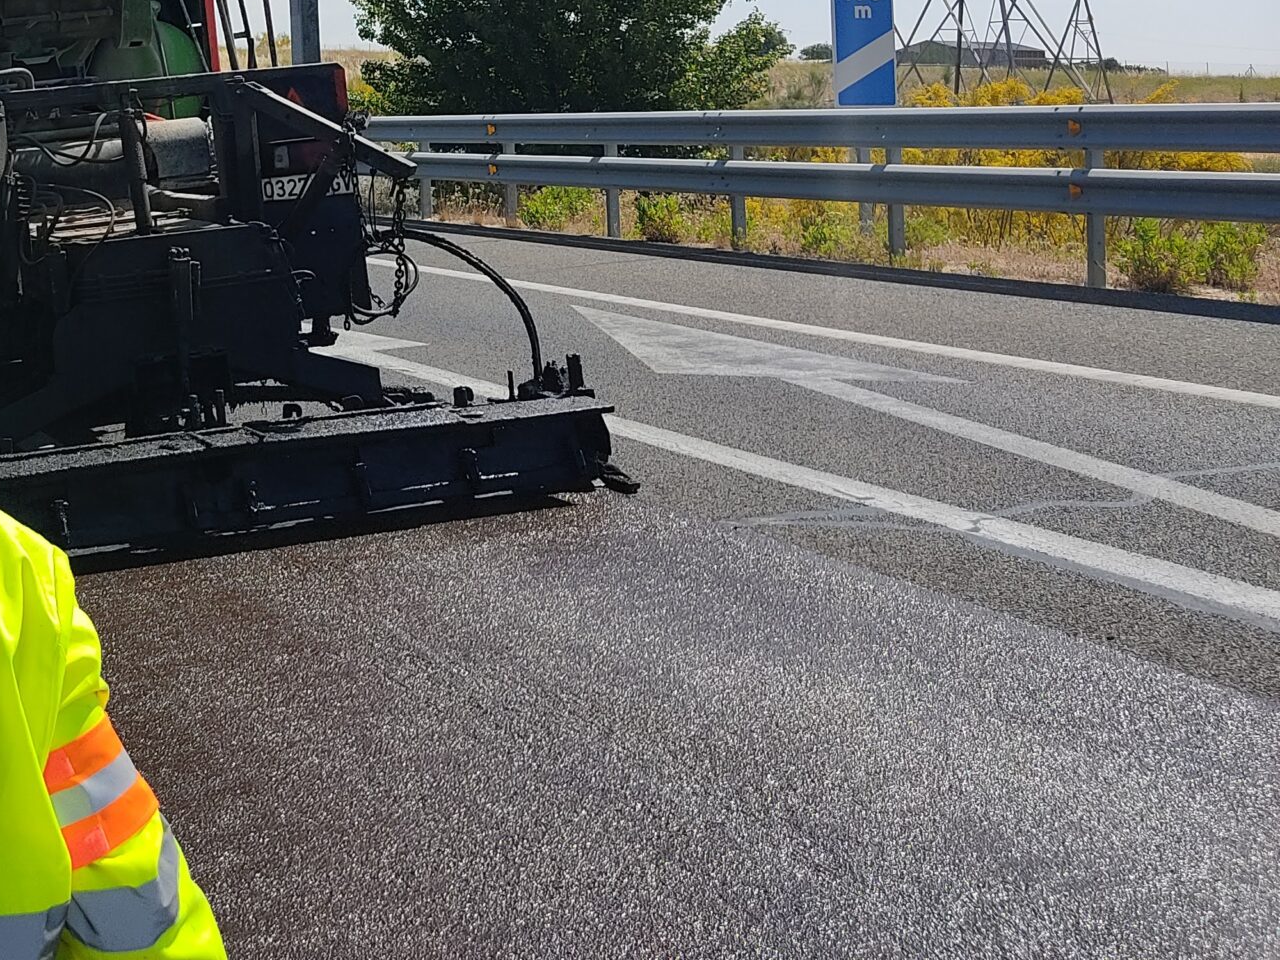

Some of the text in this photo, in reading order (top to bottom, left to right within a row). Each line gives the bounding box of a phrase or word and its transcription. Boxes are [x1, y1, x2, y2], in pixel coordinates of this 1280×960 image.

[854, 5, 872, 19] m
[263, 168, 352, 199] 0327 GV
